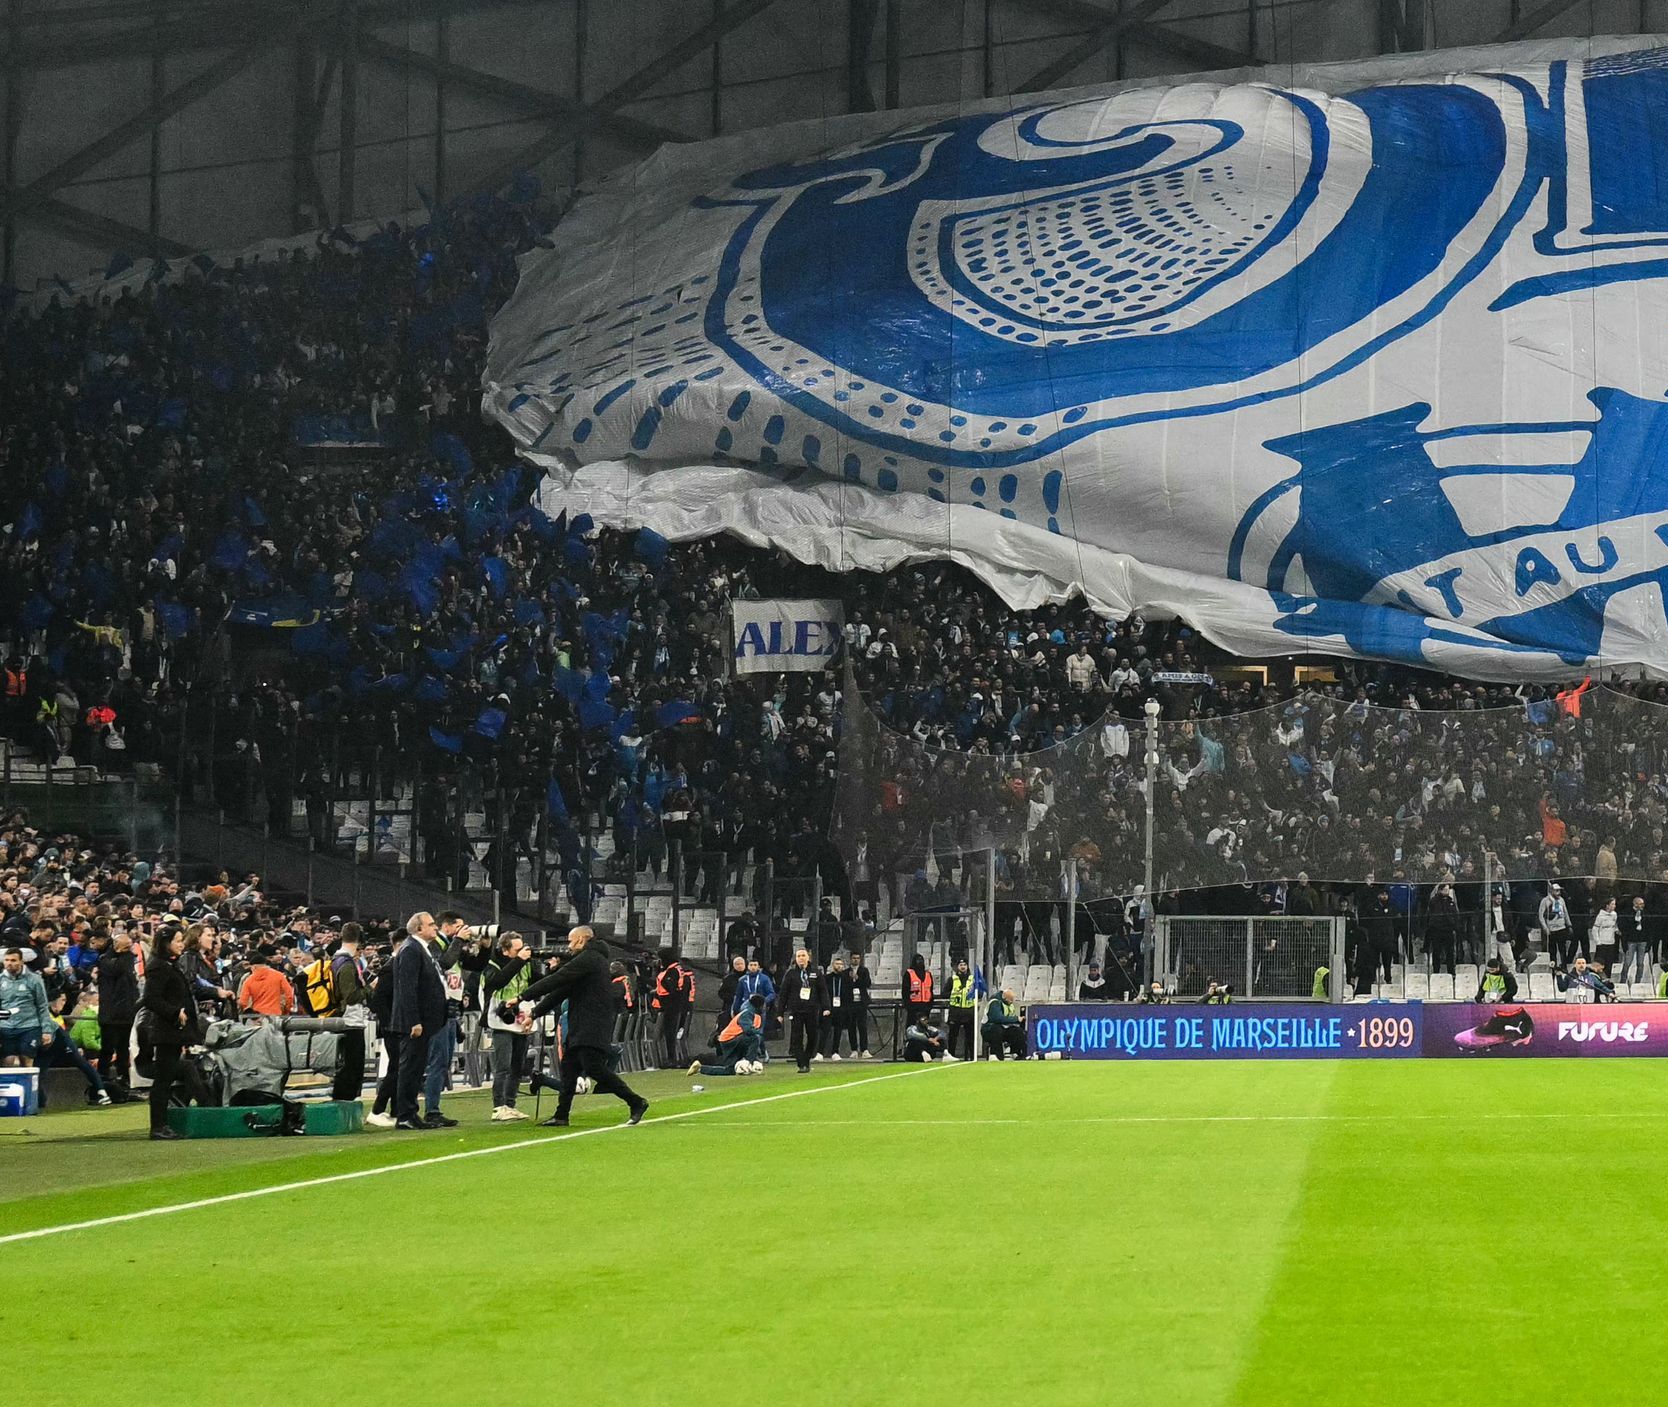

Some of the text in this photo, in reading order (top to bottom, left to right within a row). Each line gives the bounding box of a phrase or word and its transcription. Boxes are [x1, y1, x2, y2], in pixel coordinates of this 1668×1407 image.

[1514, 535, 1618, 597] AU
[1037, 1017, 1414, 1055] OLYMPIQUE DE MARSEILLE 1899
